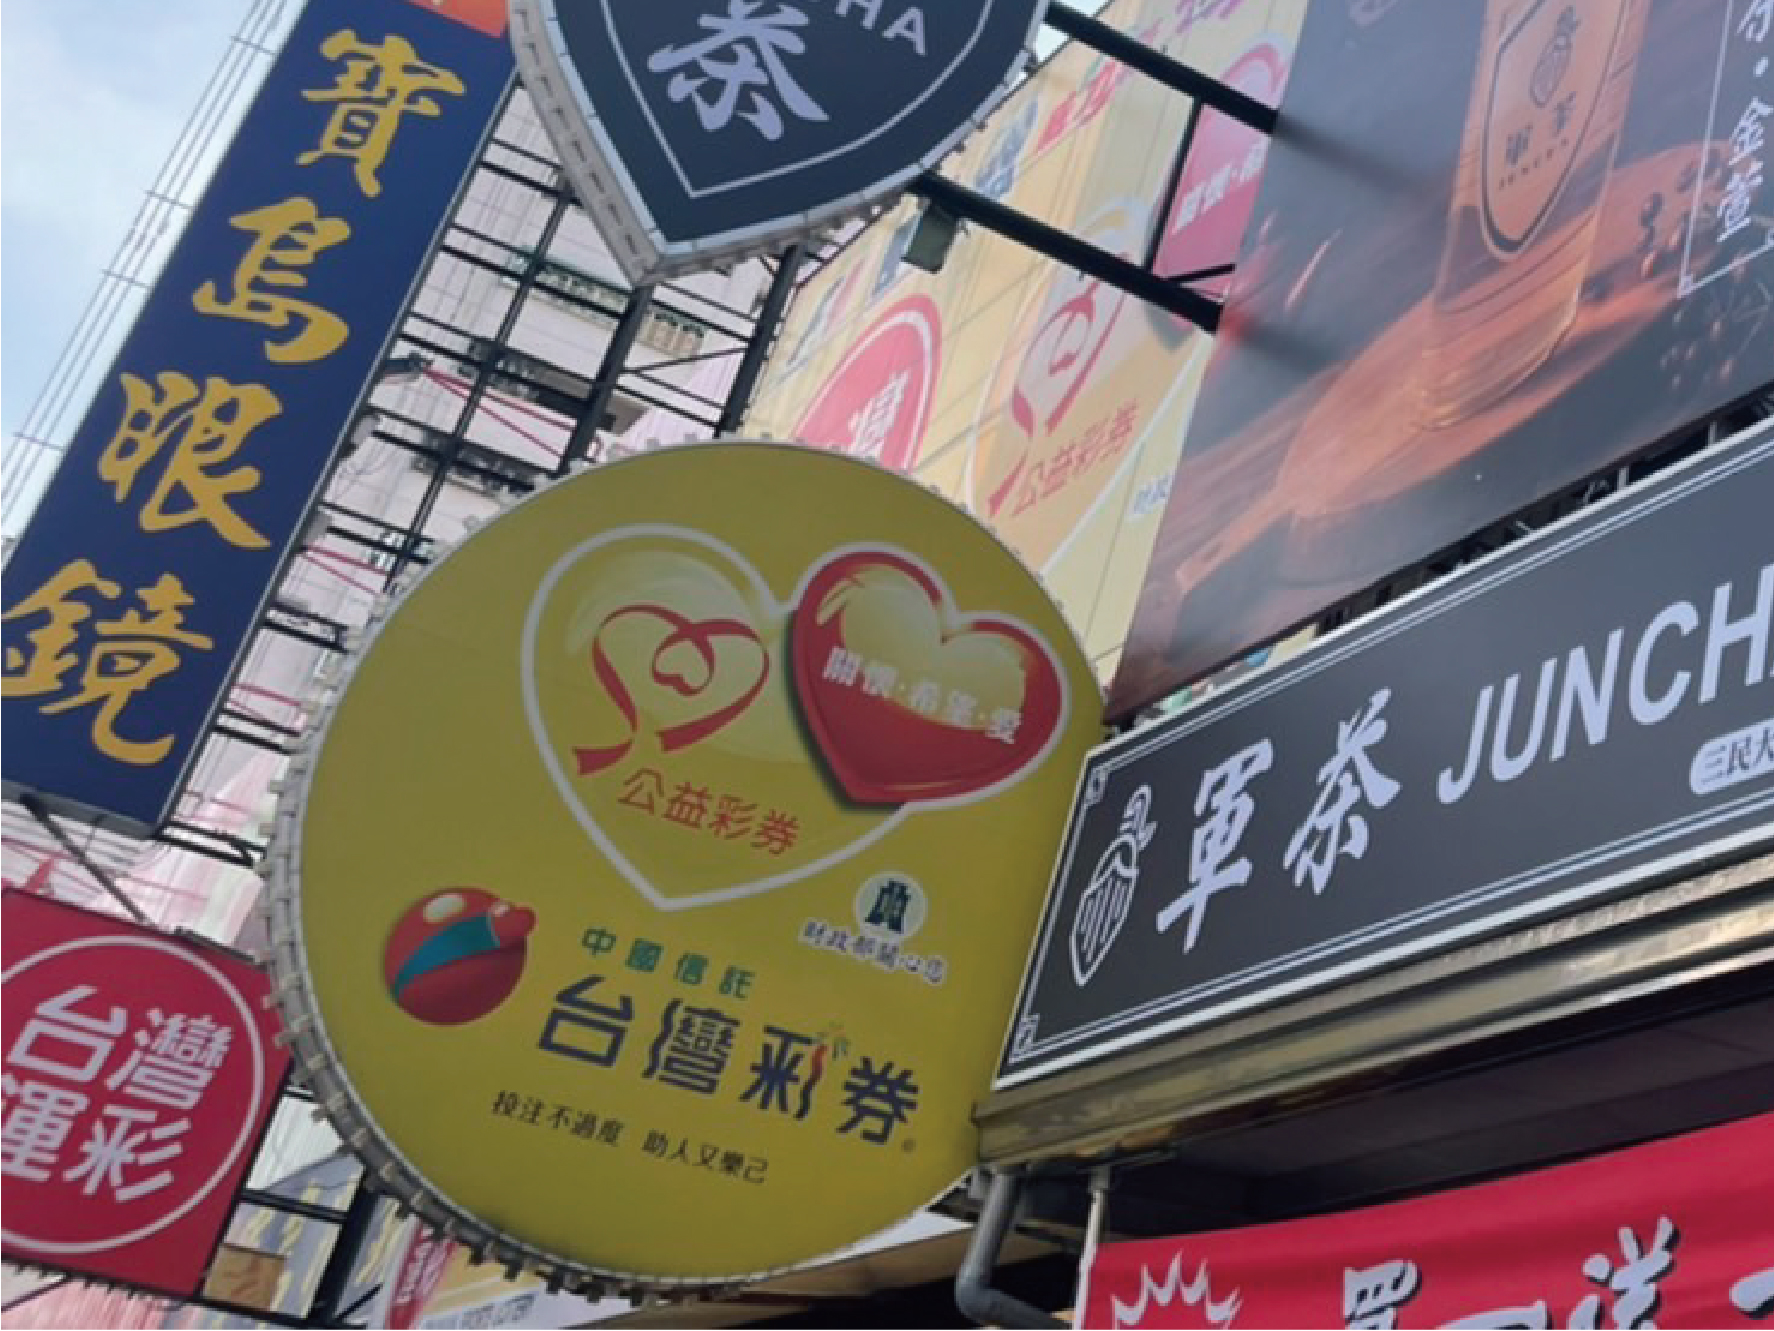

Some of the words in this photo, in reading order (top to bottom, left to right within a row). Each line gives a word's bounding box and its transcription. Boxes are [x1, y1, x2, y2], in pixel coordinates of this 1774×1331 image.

[2, 28, 466, 766] 寶島眼鏡
[617, 768, 800, 856] 公益彩券
[1157, 687, 1404, 952] 軍茶
[580, 924, 757, 1003] 中國信託
[30, 985, 227, 1112] 台灣
[537, 973, 920, 1146] 台灣彩券
[1, 1070, 196, 1204] 運彩
